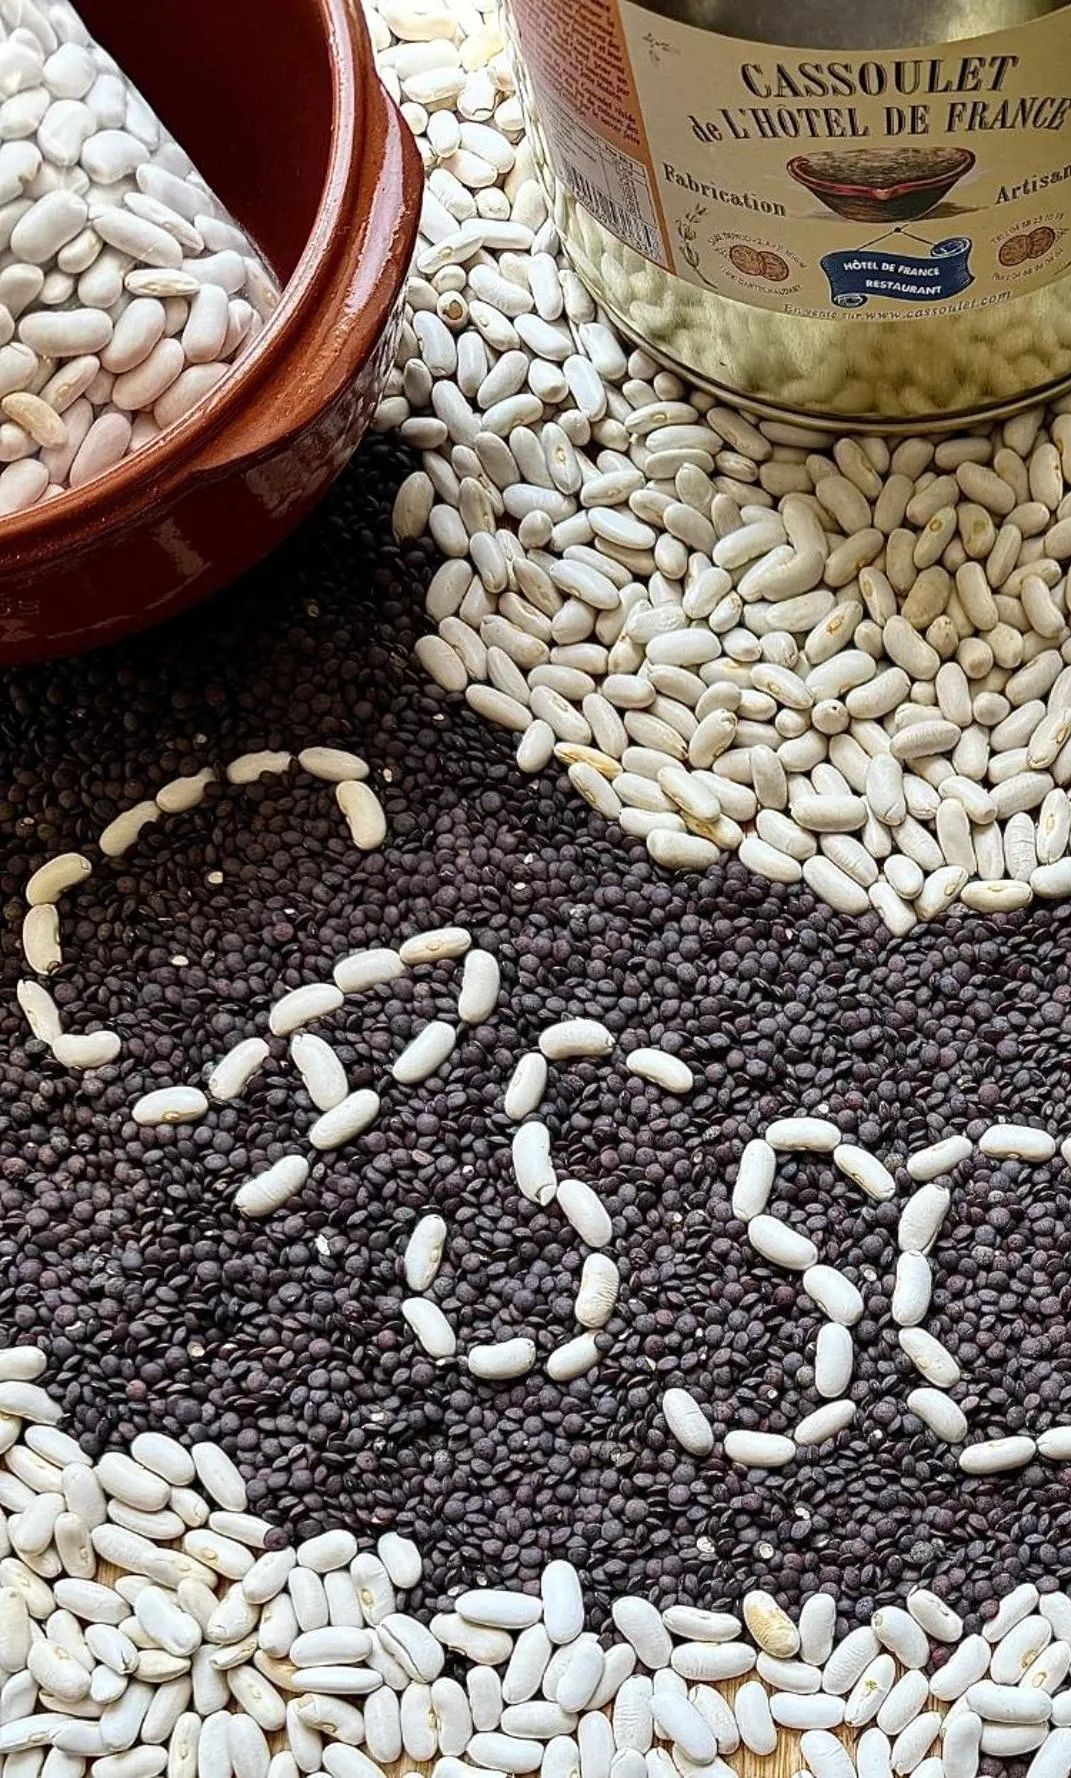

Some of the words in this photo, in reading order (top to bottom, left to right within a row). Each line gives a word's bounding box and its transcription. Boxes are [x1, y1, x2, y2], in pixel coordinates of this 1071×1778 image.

[741, 56, 1019, 98] CASSOULET
[687, 114, 722, 143] de
[719, 104, 869, 139] L'HÔTEL
[884, 104, 930, 136] DE
[662, 161, 786, 217] Fabrication
[843, 260, 878, 272] HÔTEL
[882, 263, 895, 273] DE
[898, 265, 940, 276] FRANCE
[865, 279, 942, 295] RESTAURANT
